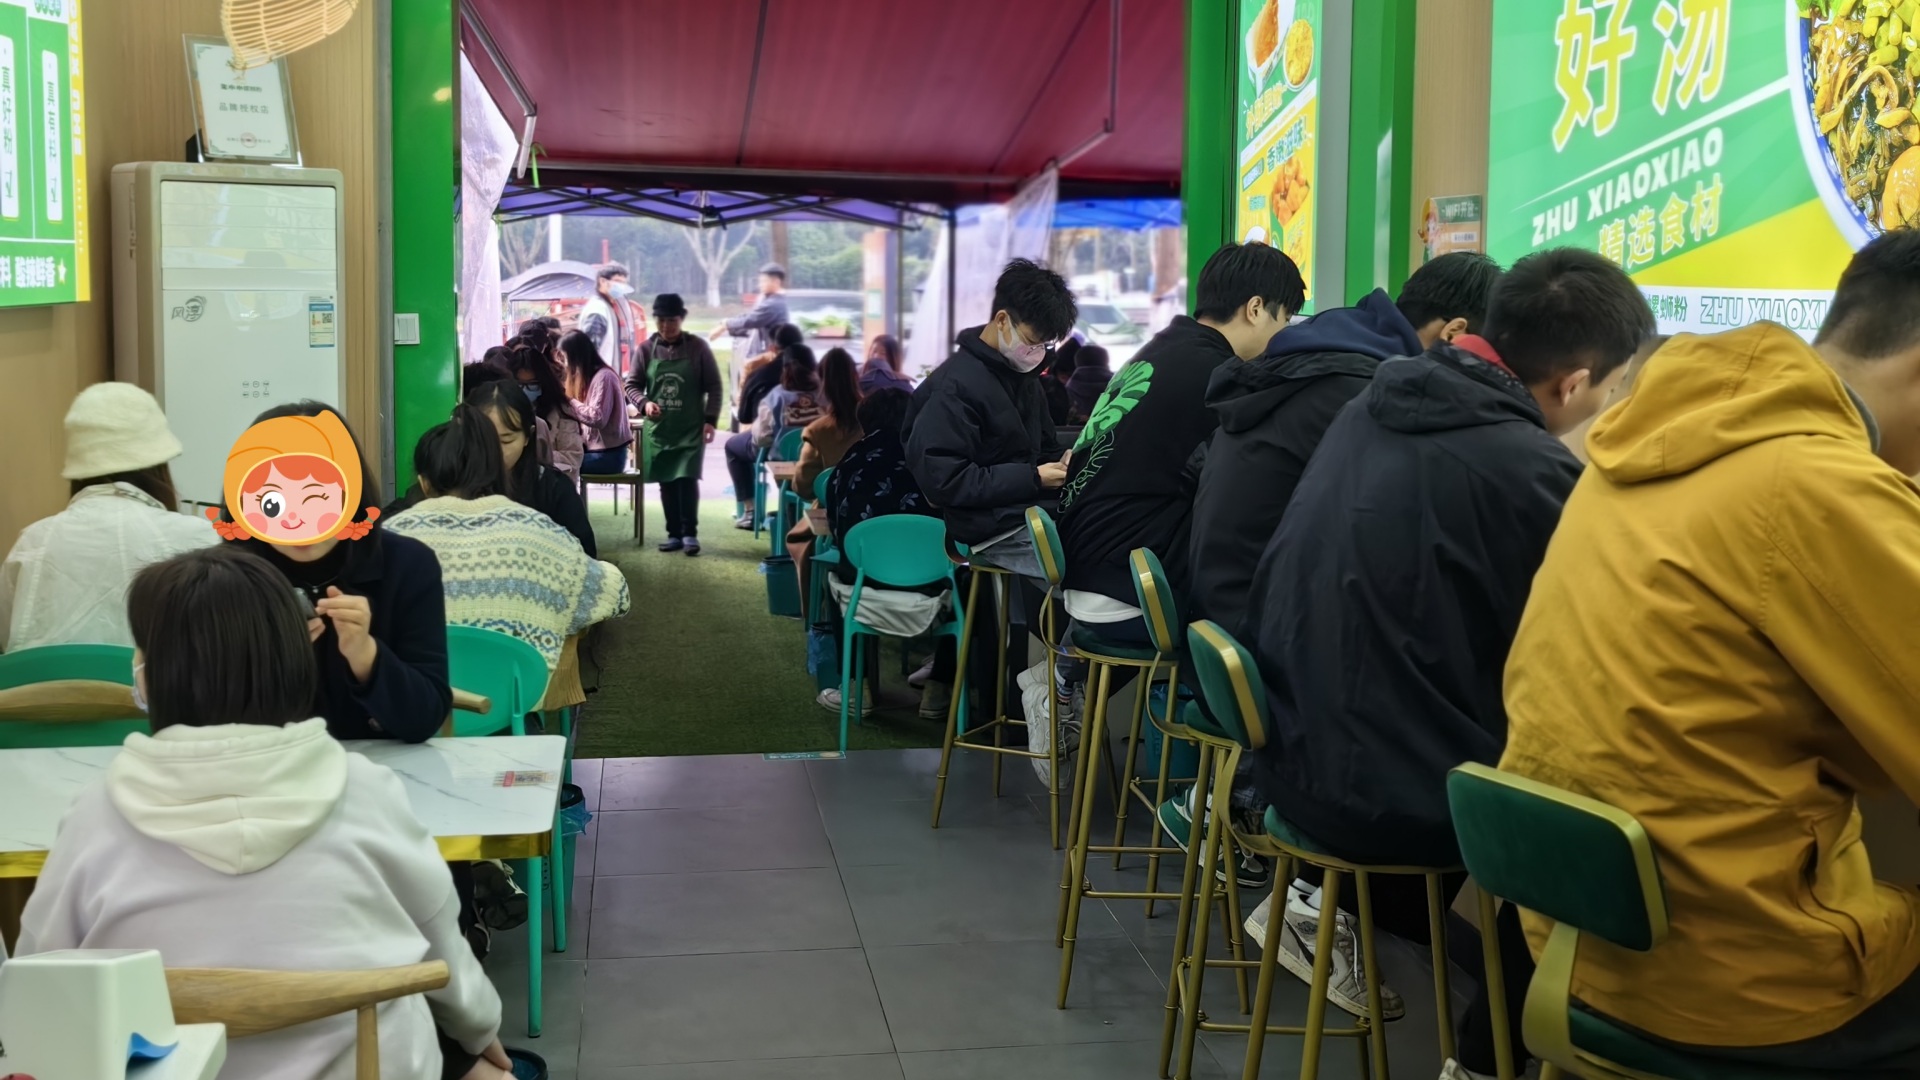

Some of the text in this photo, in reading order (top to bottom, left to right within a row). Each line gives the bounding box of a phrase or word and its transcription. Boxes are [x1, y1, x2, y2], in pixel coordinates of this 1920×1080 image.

[1552, 0, 1731, 152] 好汤
[1531, 126, 1724, 248] ZHU XIAOXIAO
[1598, 172, 1724, 270] 精选食材
[1700, 296, 1744, 327] ZHU
